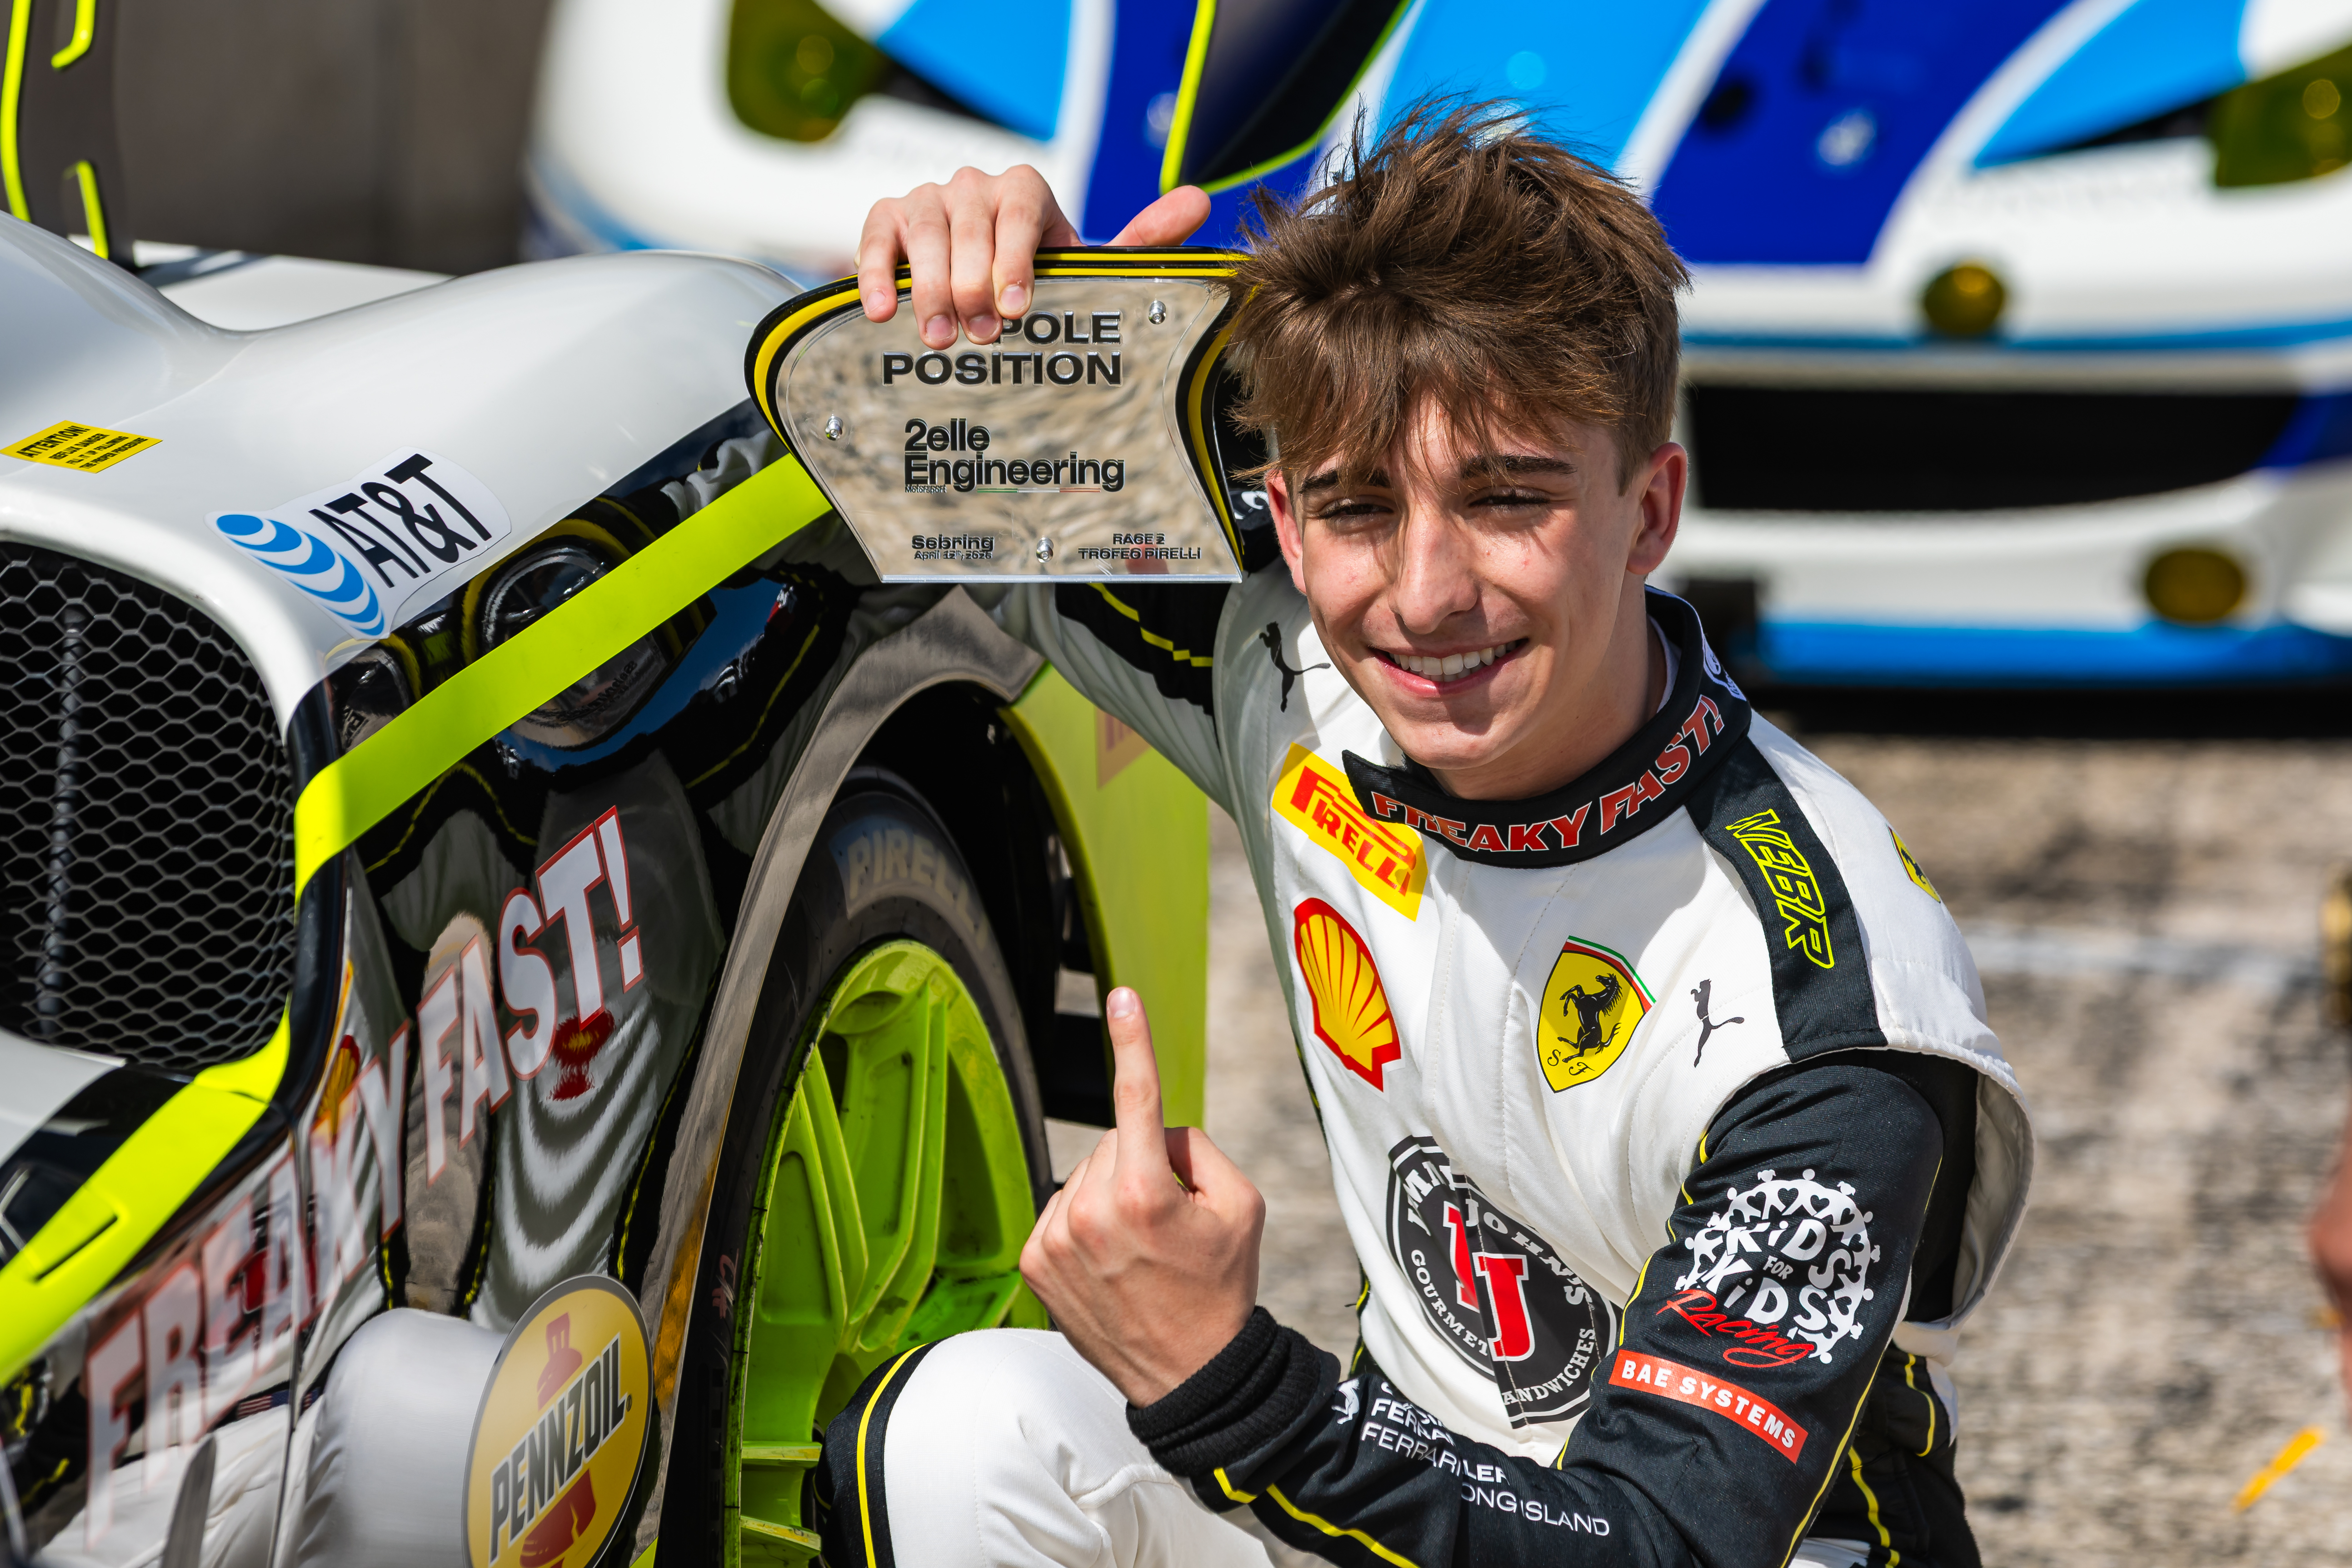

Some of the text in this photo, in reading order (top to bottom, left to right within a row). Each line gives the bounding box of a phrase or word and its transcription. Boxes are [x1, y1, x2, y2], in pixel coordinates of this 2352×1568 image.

[882, 350, 1122, 385] POSITION
[16, 425, 91, 458] ATTENTION!
[48, 433, 110, 460] REFLUX DANGER
[65, 456, 84, 465] FILL
[93, 435, 130, 451] FOLLOWING
[904, 418, 990, 451] 2elle
[79, 460, 97, 469] THE
[904, 451, 1125, 493] Engineering
[905, 484, 947, 494] Motorsport
[308, 453, 492, 588] AT&T
[912, 534, 994, 552] Sebring
[914, 549, 940, 561] April
[1078, 547, 1202, 559] TROFEO PIRELLI
[1113, 533, 1165, 545] RACE 2
[1371, 694, 1725, 852] FREAKY FAST!
[1290, 765, 1417, 897] PIRELLI
[85, 805, 644, 1553] FREAKY FAST!
[1763, 1255, 1794, 1280] FOR
[1411, 1249, 1488, 1356] GOURMET
[1656, 1289, 1815, 1368] Racing
[1502, 1328, 1596, 1405] ANDWICHES
[1621, 1359, 1796, 1448] BAE SYSTEMS
[489, 1332, 628, 1567] PENNZOIL
[1361, 1421, 1610, 1537] FERRARI ONG ISLAND
